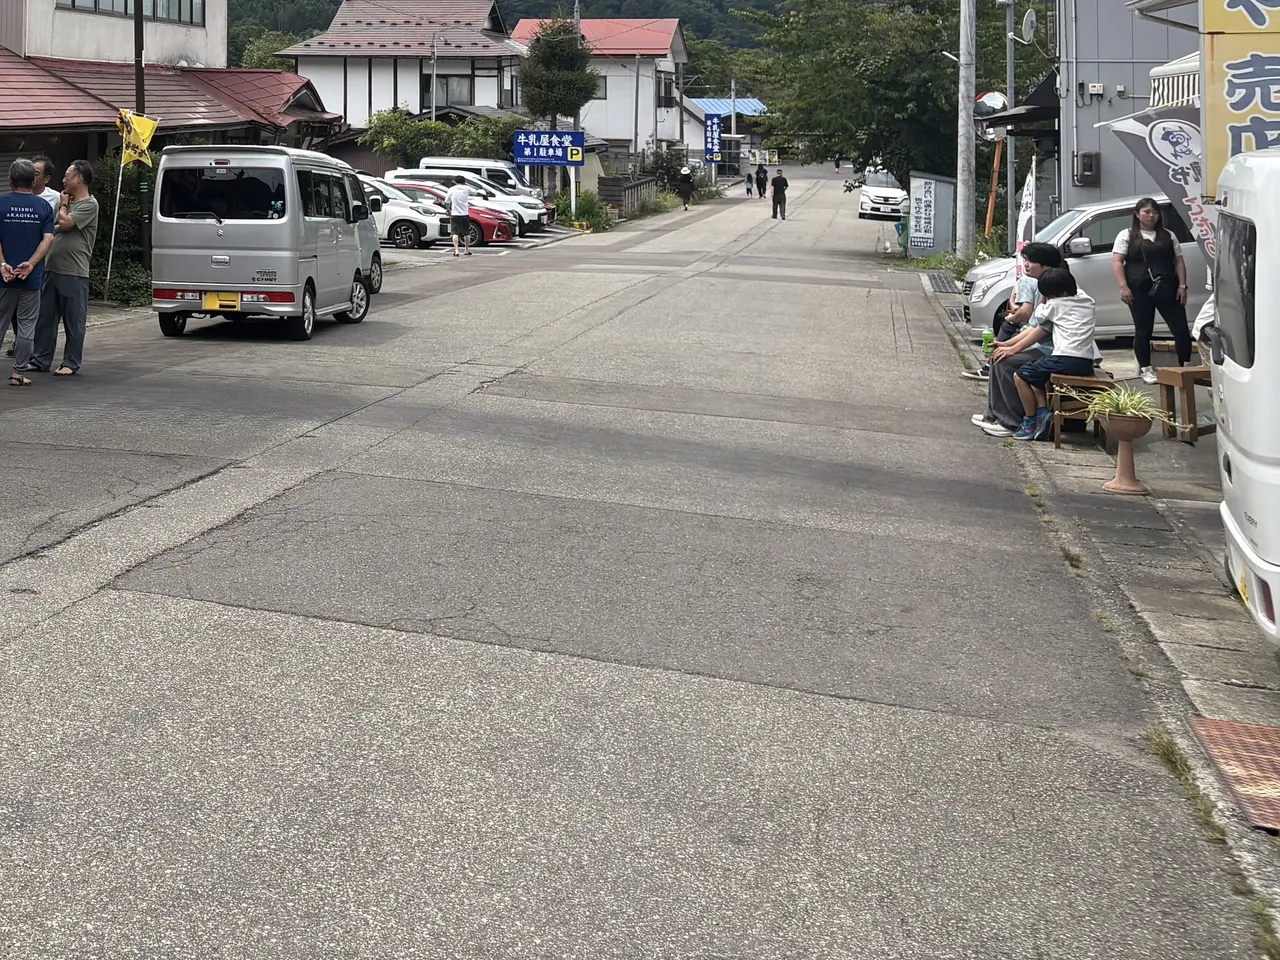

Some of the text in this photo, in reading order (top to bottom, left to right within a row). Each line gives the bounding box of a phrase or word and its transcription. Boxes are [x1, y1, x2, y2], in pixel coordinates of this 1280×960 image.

[517, 133, 573, 146] 牛乳屋食堂
[712, 117, 720, 152] 牛乳屋食堂
[524, 147, 563, 157] 第1駐車場
[570, 148, 580, 159] P
